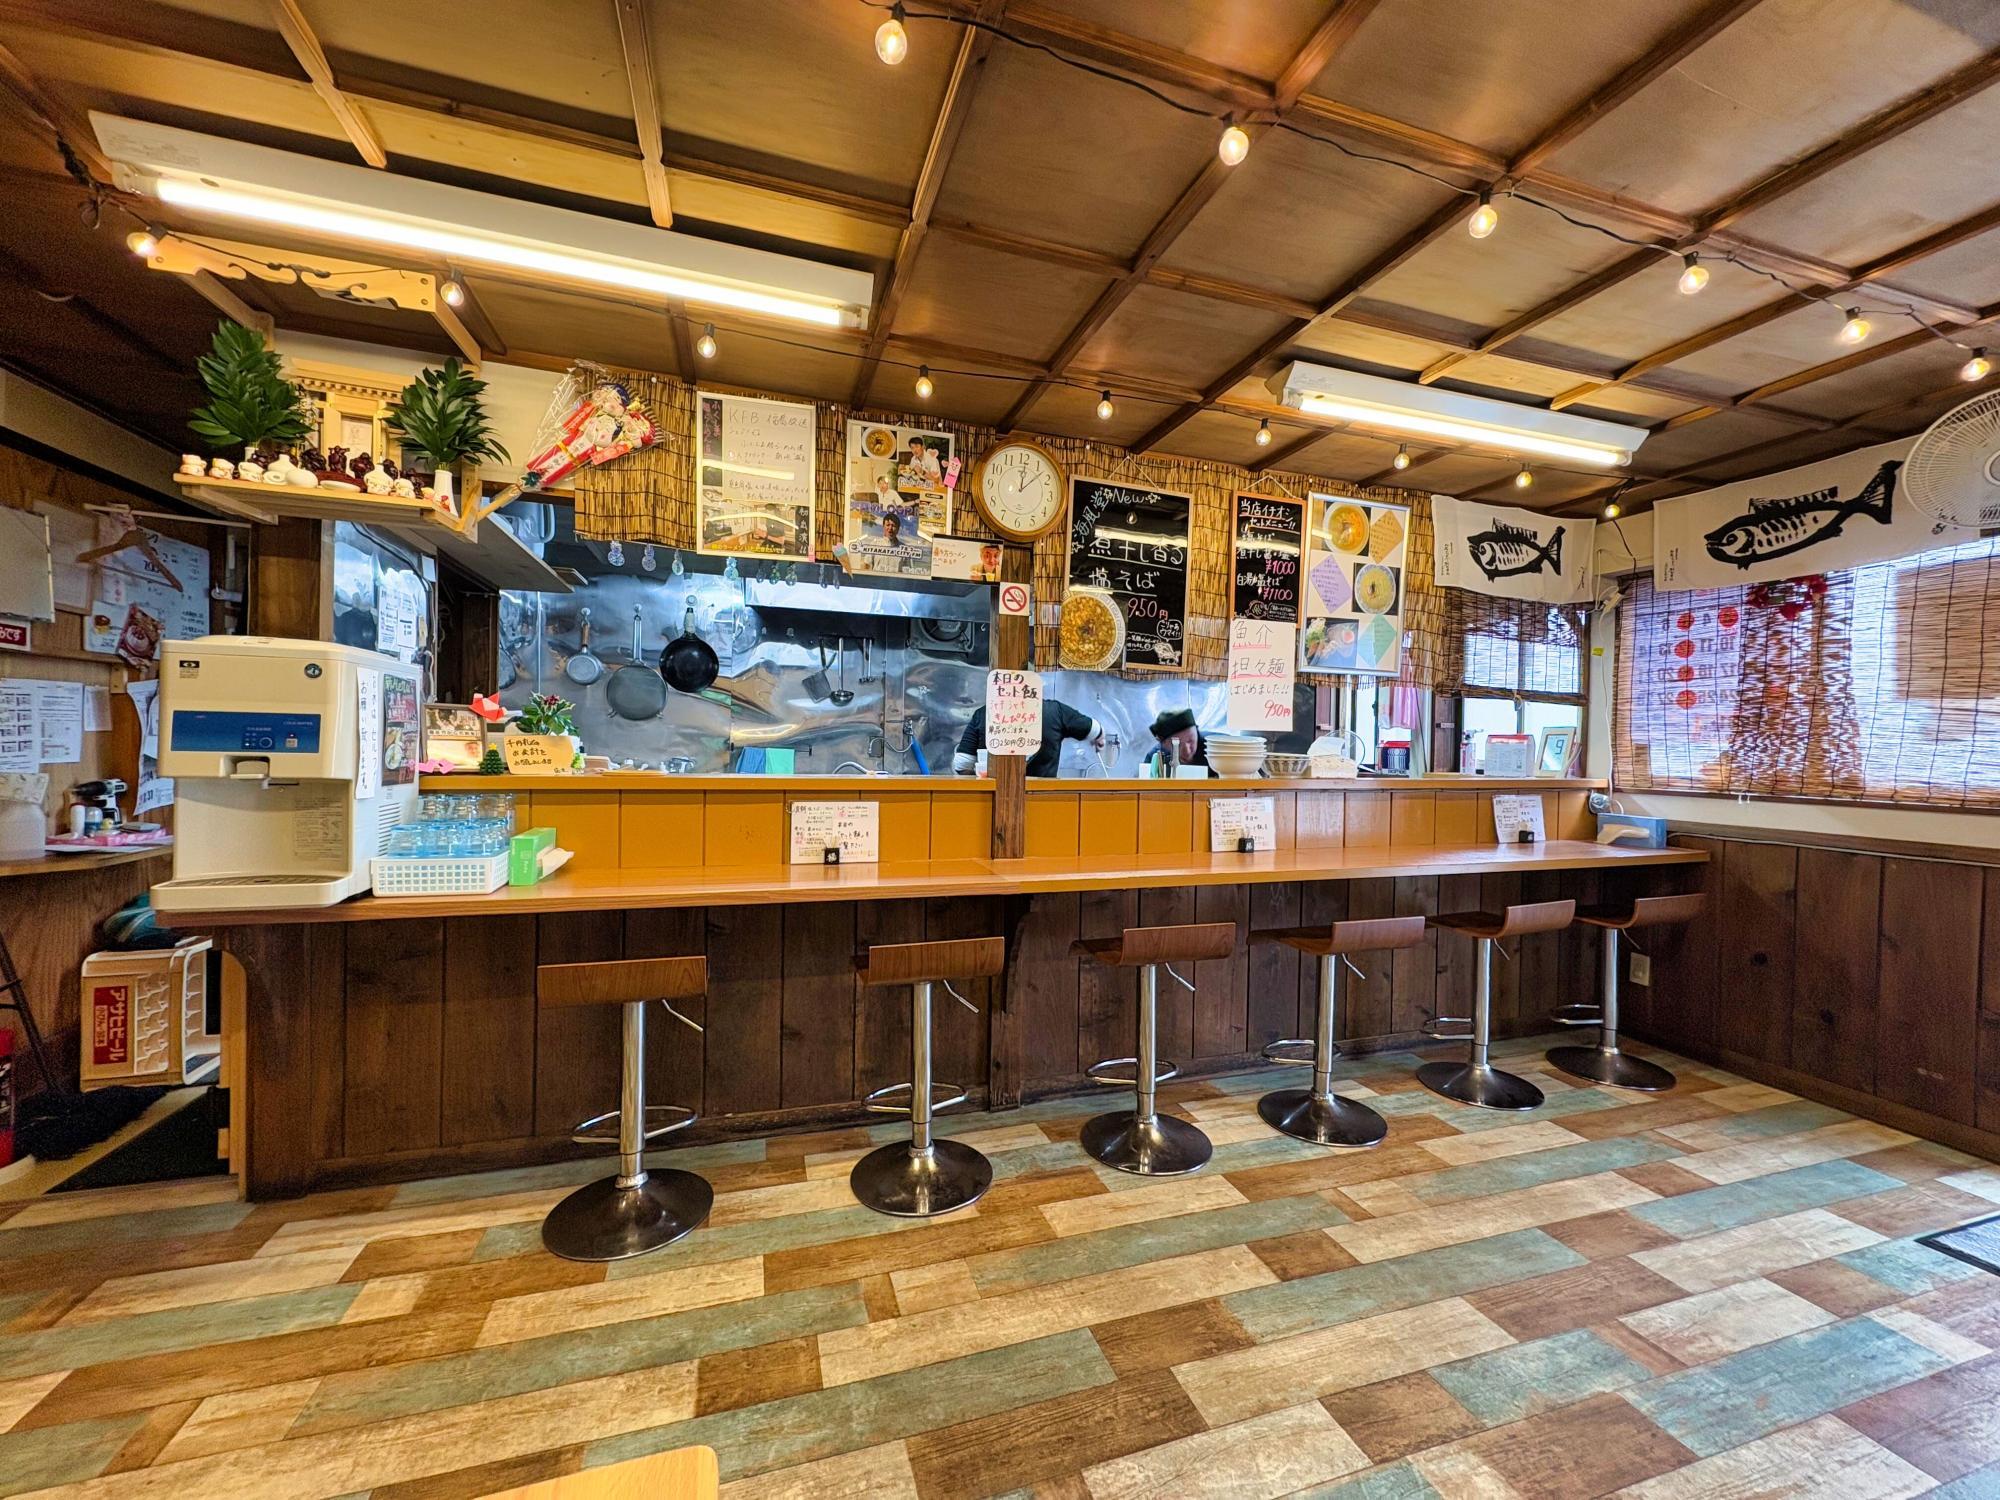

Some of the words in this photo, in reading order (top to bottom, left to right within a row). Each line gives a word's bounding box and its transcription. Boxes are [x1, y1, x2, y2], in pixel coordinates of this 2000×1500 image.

[729, 408, 760, 424] KFB
[1004, 454, 1014, 466] 11
[1019, 453, 1030, 465] 12
[992, 463, 1003, 475] 10
[1036, 461, 1040, 472] 1
[988, 479, 994, 489] 9
[1044, 474, 1051, 486] 2
[990, 496, 997, 507] 8
[1046, 491, 1053, 502] 3
[1112, 488, 1145, 504] New
[1001, 509, 1006, 521] 7
[1041, 507, 1047, 517] 4
[1241, 499, 1294, 522] 当店イチオシ
[1014, 517, 1020, 528] 6
[1030, 516, 1036, 527] 5
[863, 547, 895, 555] KITAKATA
[1088, 537, 1184, 565] 煮干し香る
[1088, 567, 1160, 591] 塩そば
[1263, 587, 1293, 600] ¥1100
[1233, 620, 1274, 648] 魚介
[992, 671, 1025, 685] 本日の
[997, 684, 1039, 700] セット飯
[1264, 699, 1291, 719] 950円
[109, 988, 126, 1061] アサヒビール
